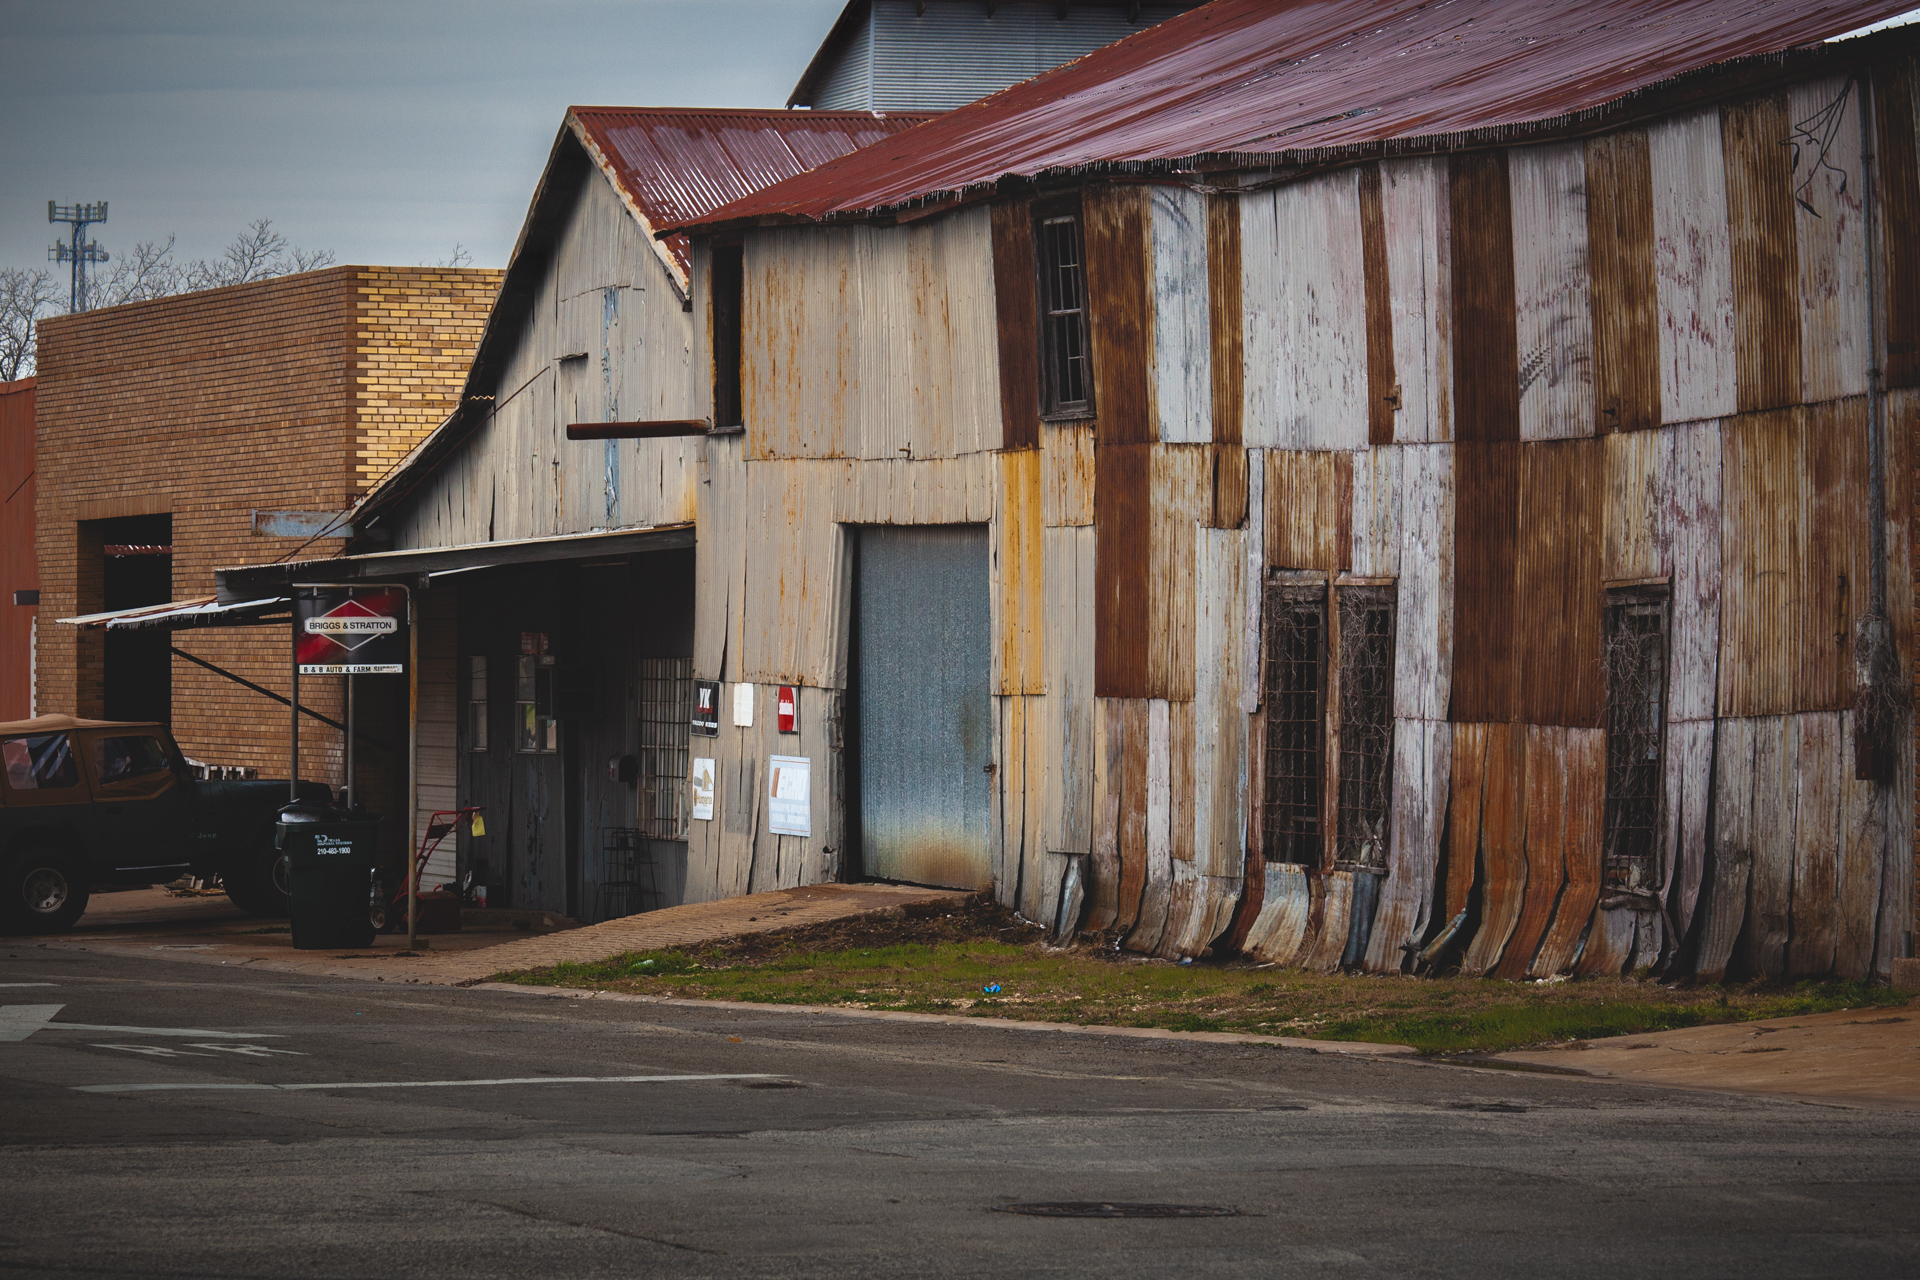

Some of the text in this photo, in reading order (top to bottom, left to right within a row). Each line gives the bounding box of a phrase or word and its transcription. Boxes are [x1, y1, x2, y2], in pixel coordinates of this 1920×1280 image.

[309, 621, 392, 630] BRIGGS & STRATTON
